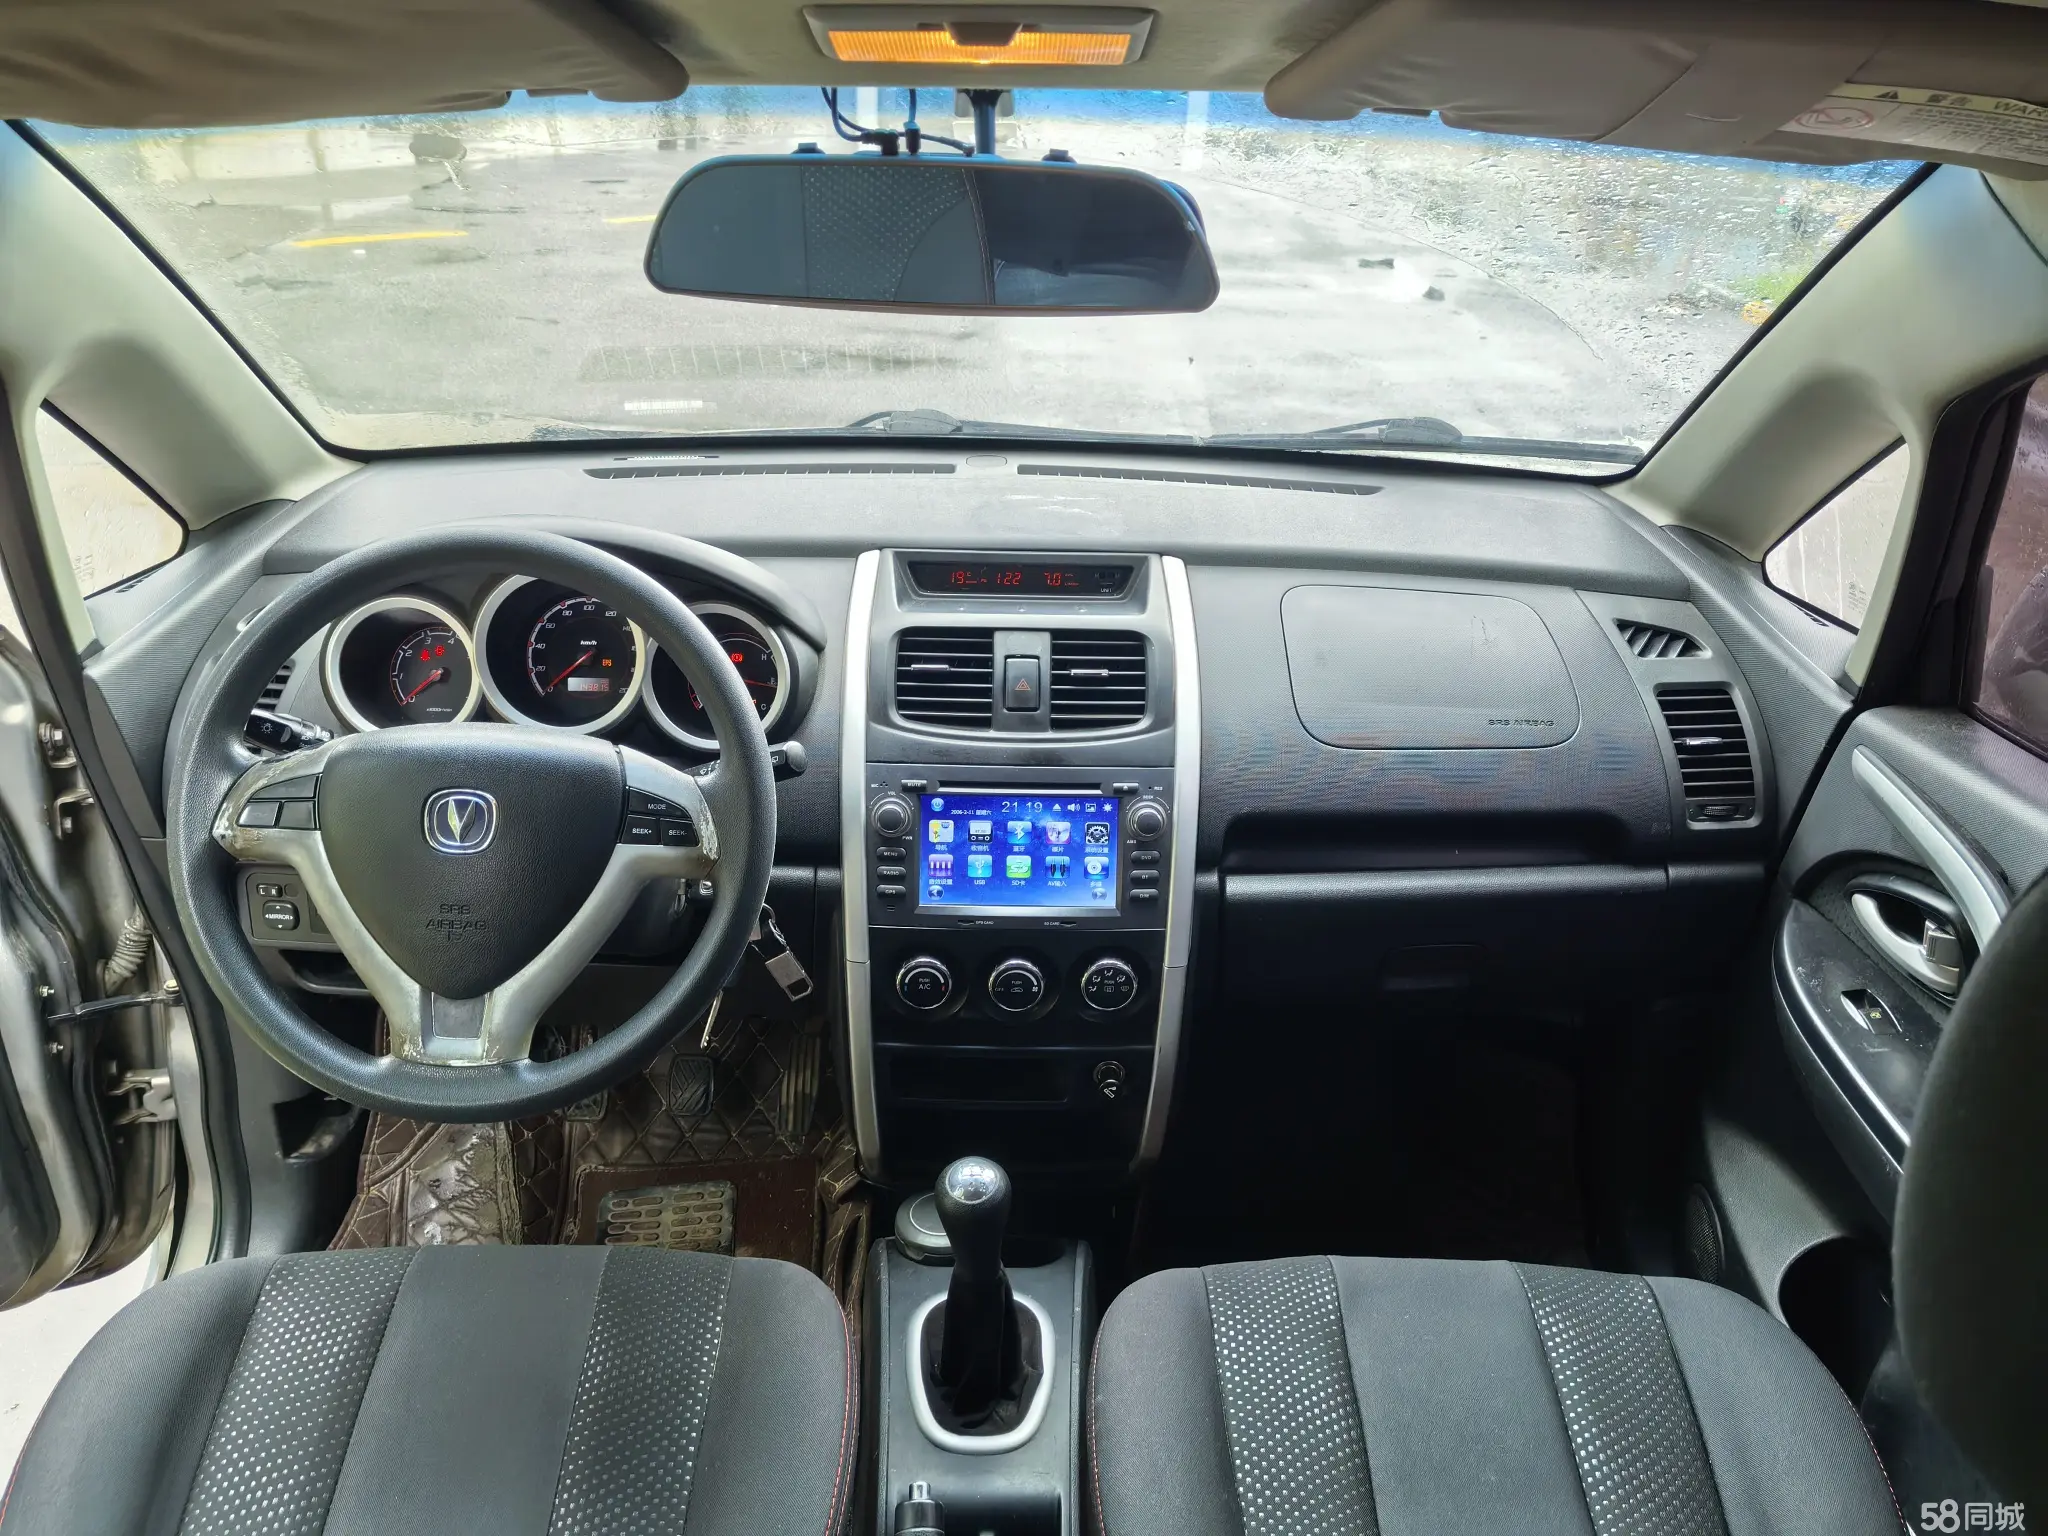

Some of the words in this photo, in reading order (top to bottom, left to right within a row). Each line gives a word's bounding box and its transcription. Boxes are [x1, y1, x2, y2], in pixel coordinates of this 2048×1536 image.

[997, 572, 1022, 585] 122
[424, 637, 432, 645] 3
[447, 637, 455, 645] 4
[405, 649, 413, 657] 2
[1488, 719, 1511, 727] SRS
[1513, 719, 1555, 728] AIRBAG
[1001, 801, 1018, 813] 21
[1025, 801, 1043, 813] 19
[439, 903, 472, 916] SRS
[426, 918, 488, 932] AIRBAG
